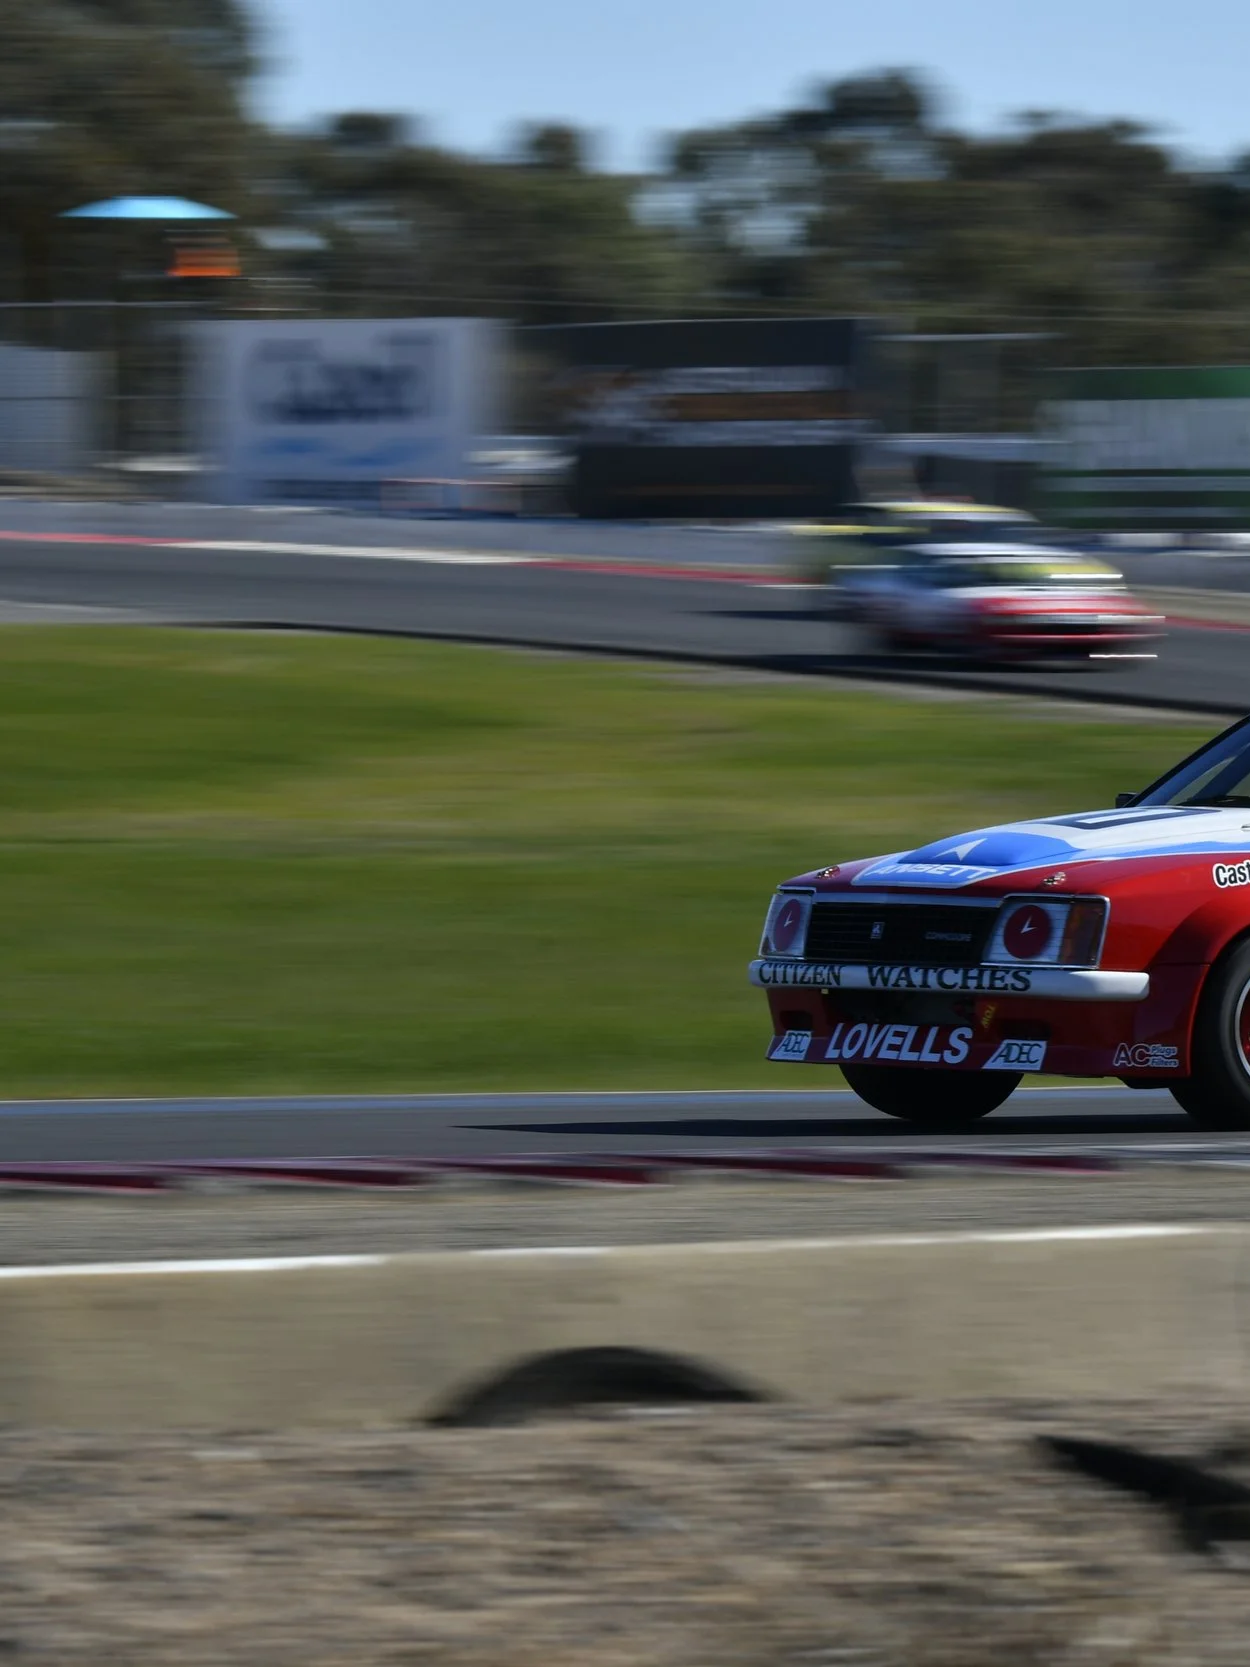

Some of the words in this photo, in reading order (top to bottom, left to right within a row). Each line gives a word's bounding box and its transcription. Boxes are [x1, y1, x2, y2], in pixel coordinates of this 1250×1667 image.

[759, 961, 845, 987] CITIZEN
[867, 965, 1033, 992] WATCHES
[776, 1032, 810, 1054] ADEC
[824, 1022, 973, 1064] LOVELLS
[992, 1042, 1043, 1064] ADEC
[1113, 1042, 1151, 1067] AC
[1151, 1045, 1177, 1057] Plugs
